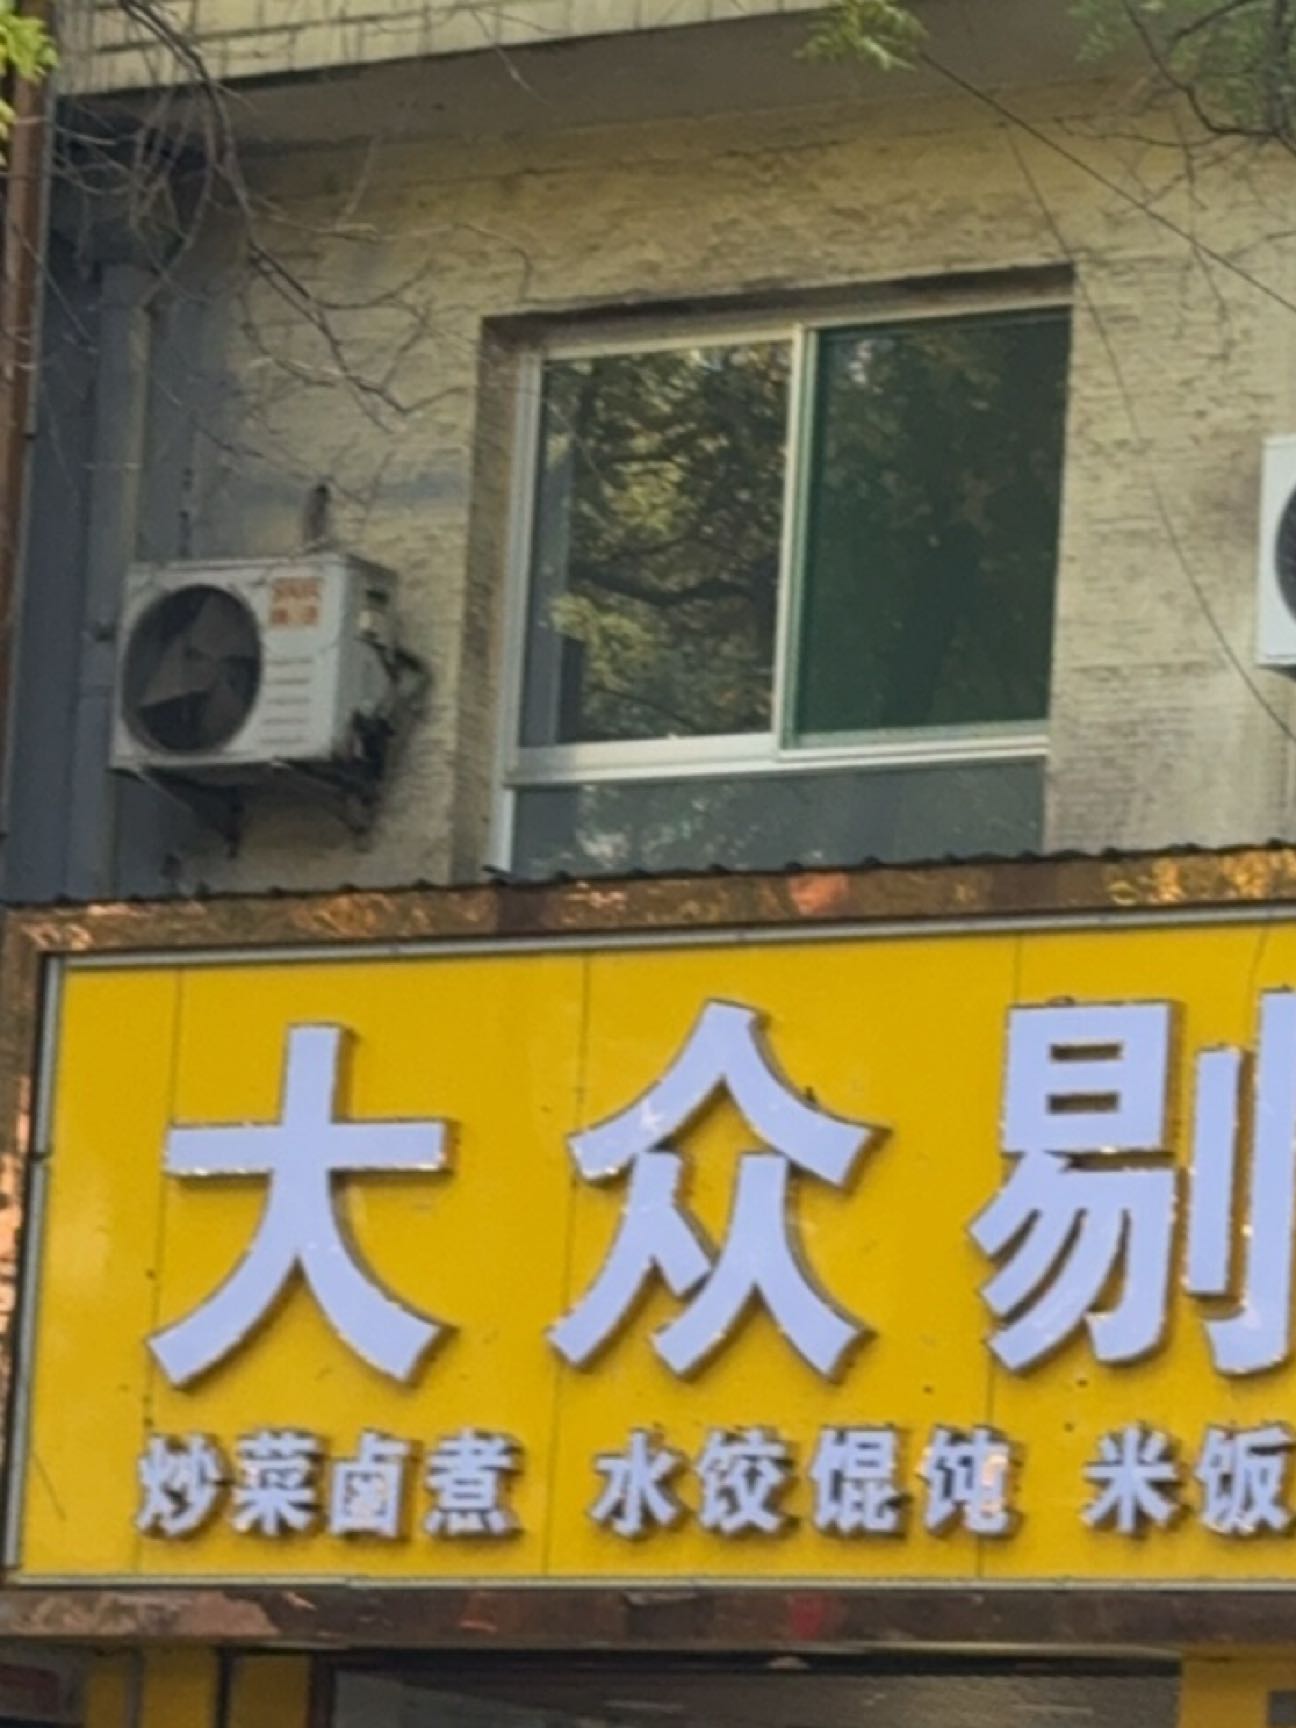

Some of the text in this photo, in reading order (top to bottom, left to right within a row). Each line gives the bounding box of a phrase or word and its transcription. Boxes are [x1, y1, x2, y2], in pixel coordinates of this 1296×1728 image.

[136, 1427, 520, 1538] 炒菜卤煮
[593, 1425, 1015, 1538] 水饺馄饨
